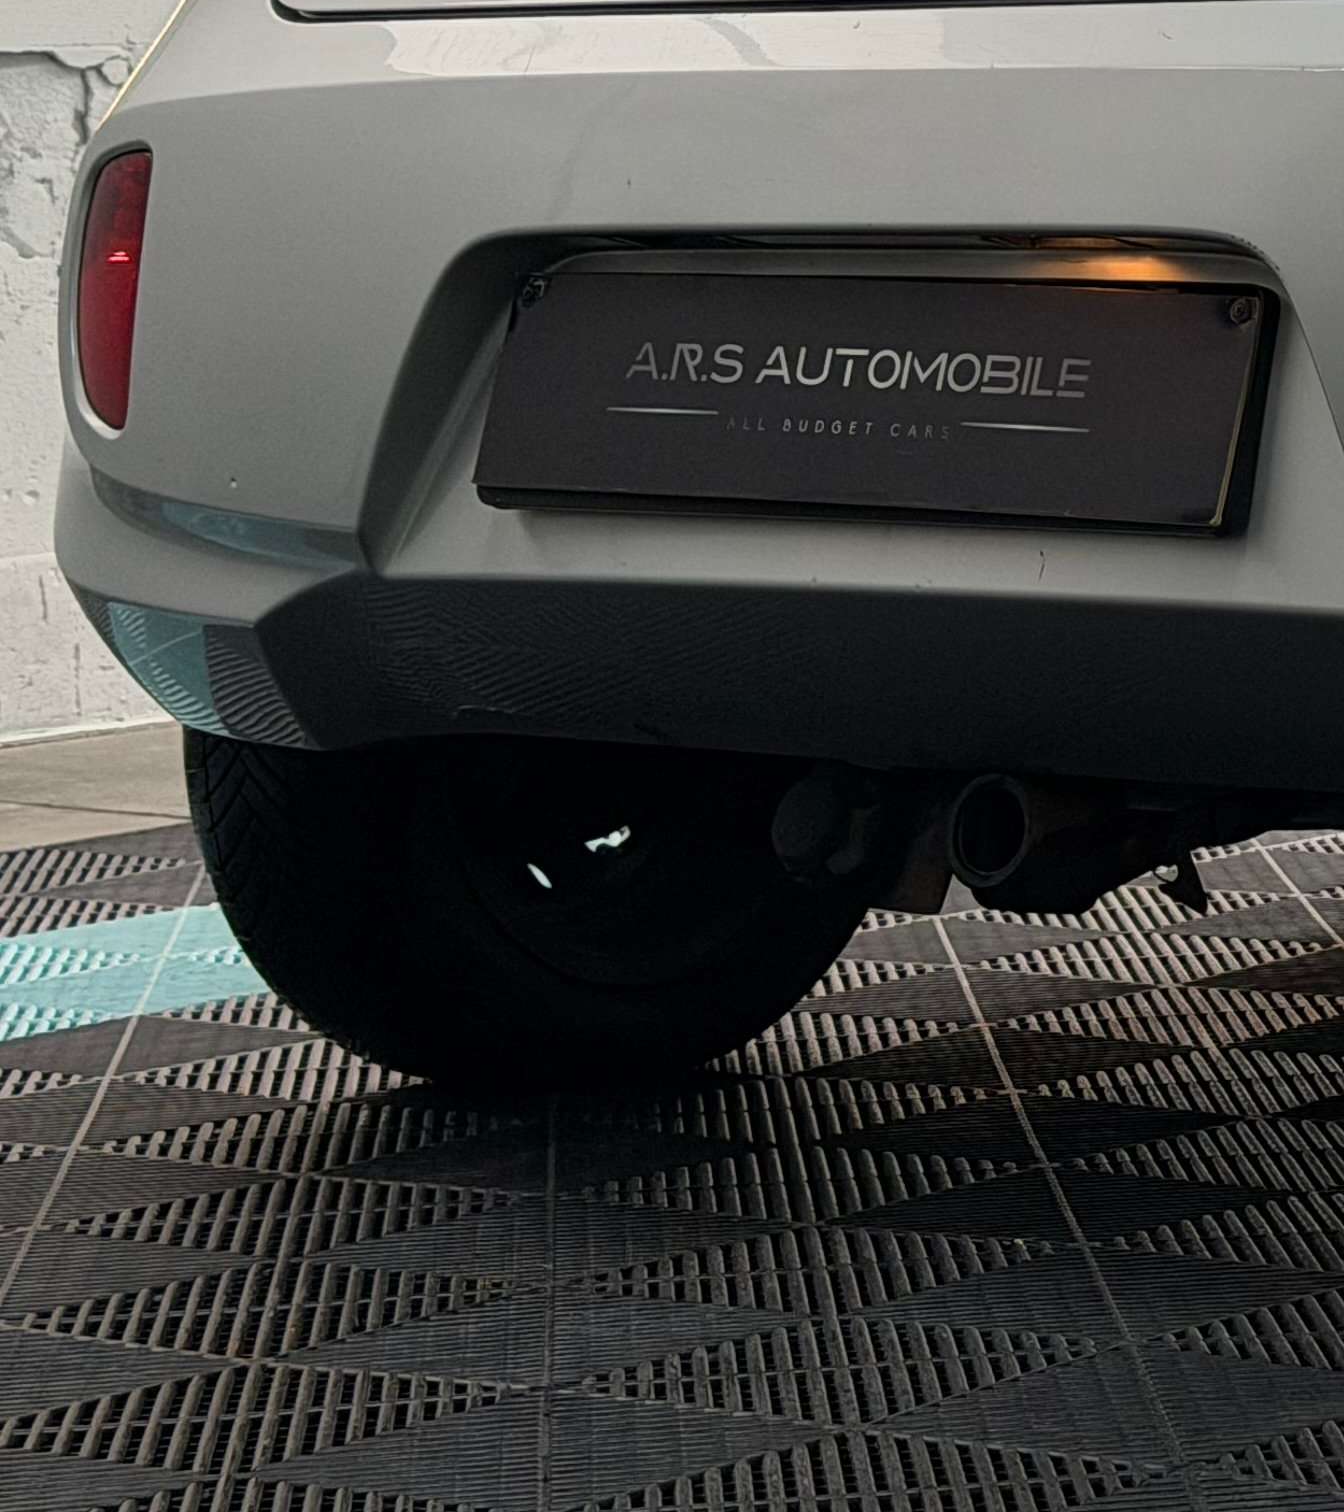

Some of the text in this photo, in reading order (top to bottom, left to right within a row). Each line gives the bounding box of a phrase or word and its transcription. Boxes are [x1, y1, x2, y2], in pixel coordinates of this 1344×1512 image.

[625, 341, 1092, 399] A.R.S AUTOMOBILE
[725, 415, 951, 442] ALL BUDGET CARS
